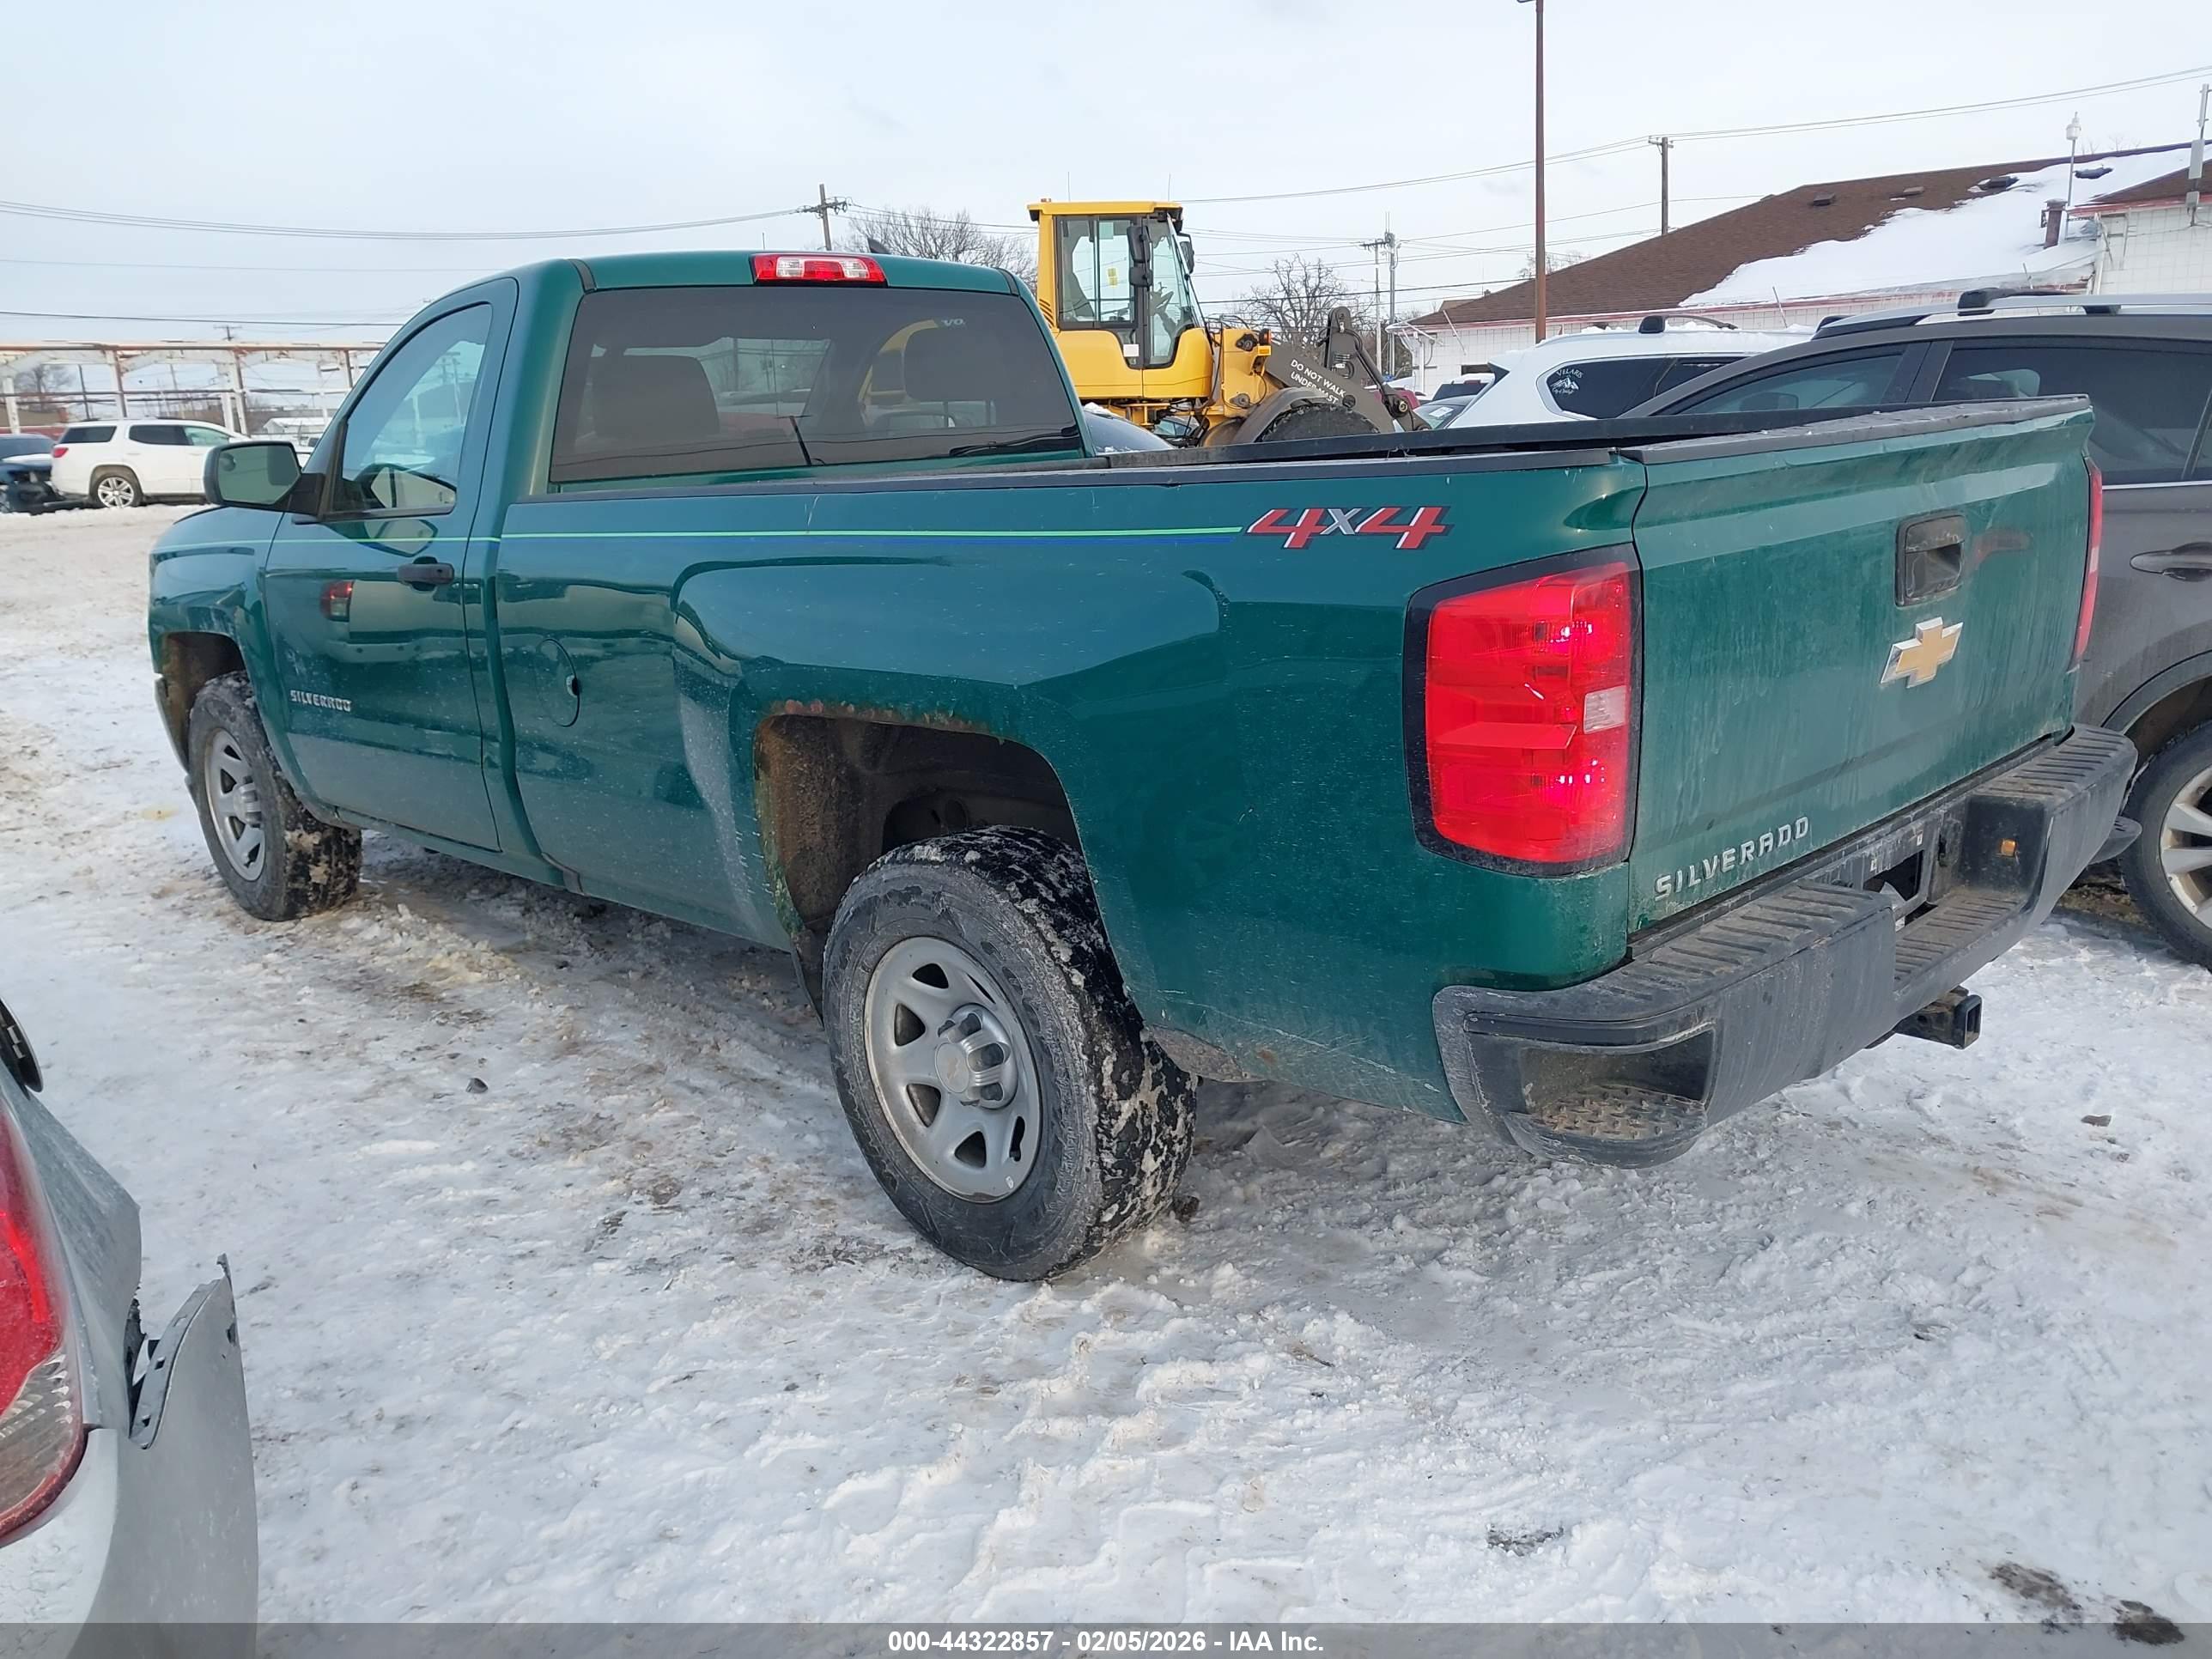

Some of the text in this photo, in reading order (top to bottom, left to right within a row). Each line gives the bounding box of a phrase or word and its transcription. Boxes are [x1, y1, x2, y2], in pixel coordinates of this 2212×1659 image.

[1291, 359, 1346, 398] DO NOT WALK
[290, 690, 351, 712] SILVERADO
[1654, 816, 1809, 902] SILVERADO
